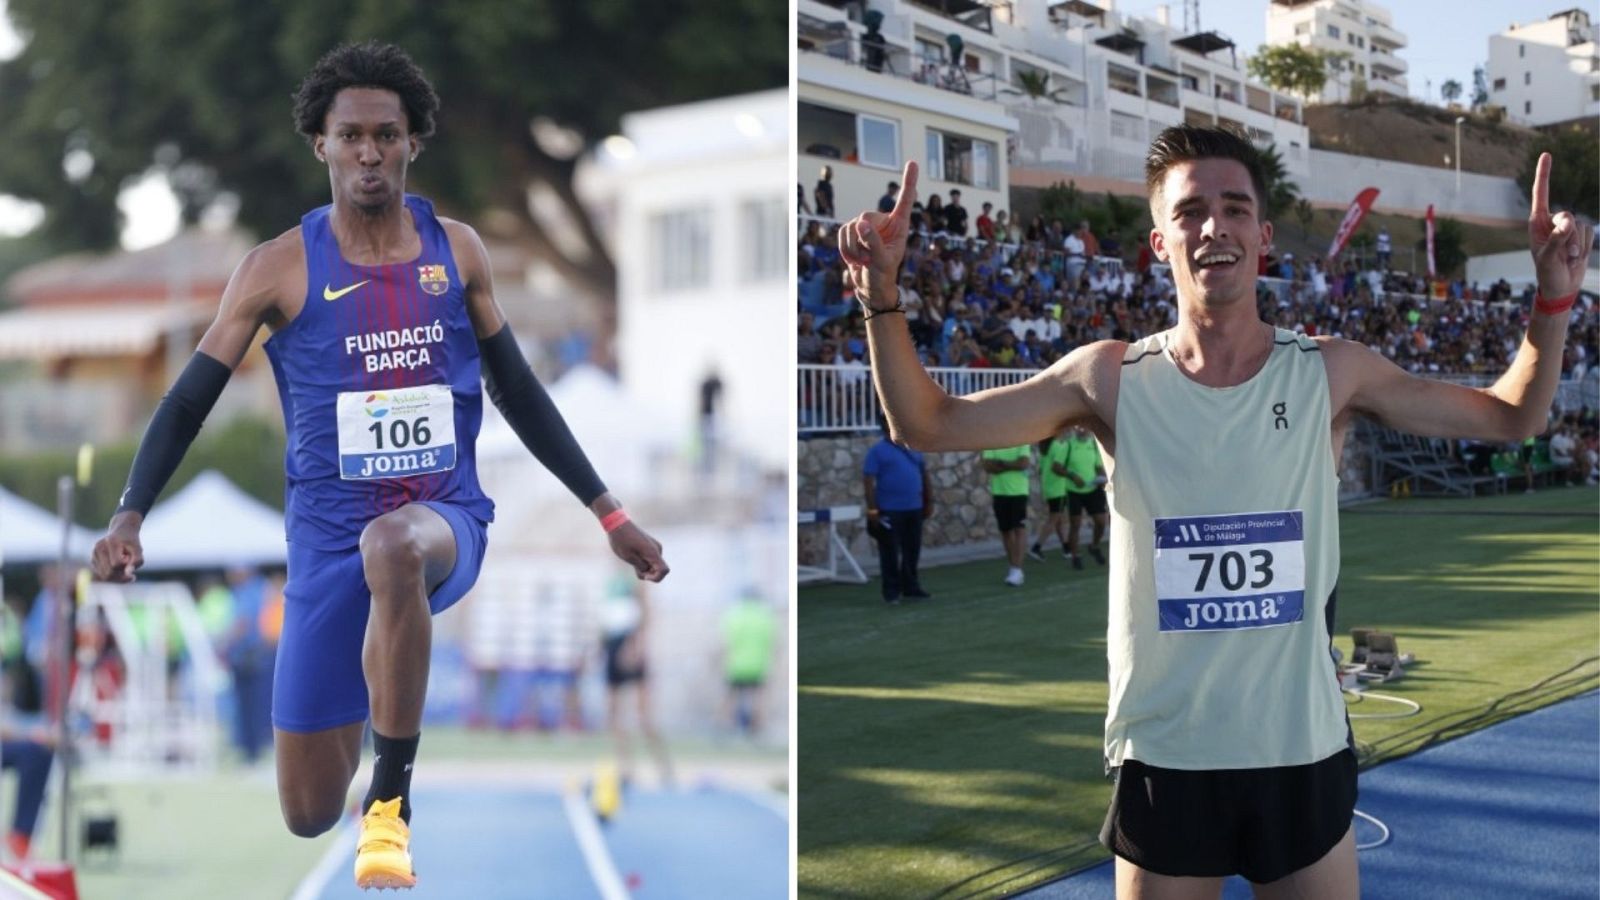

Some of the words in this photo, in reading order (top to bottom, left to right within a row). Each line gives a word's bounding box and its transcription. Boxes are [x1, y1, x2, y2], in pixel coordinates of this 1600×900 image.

[345, 319, 444, 354] FUNDACIÓ
[365, 348, 431, 373] BARÇA
[368, 416, 432, 450] 106
[1203, 521, 1246, 532] Diputación
[1248, 519, 1286, 528] Provincial
[1188, 549, 1273, 592] 703
